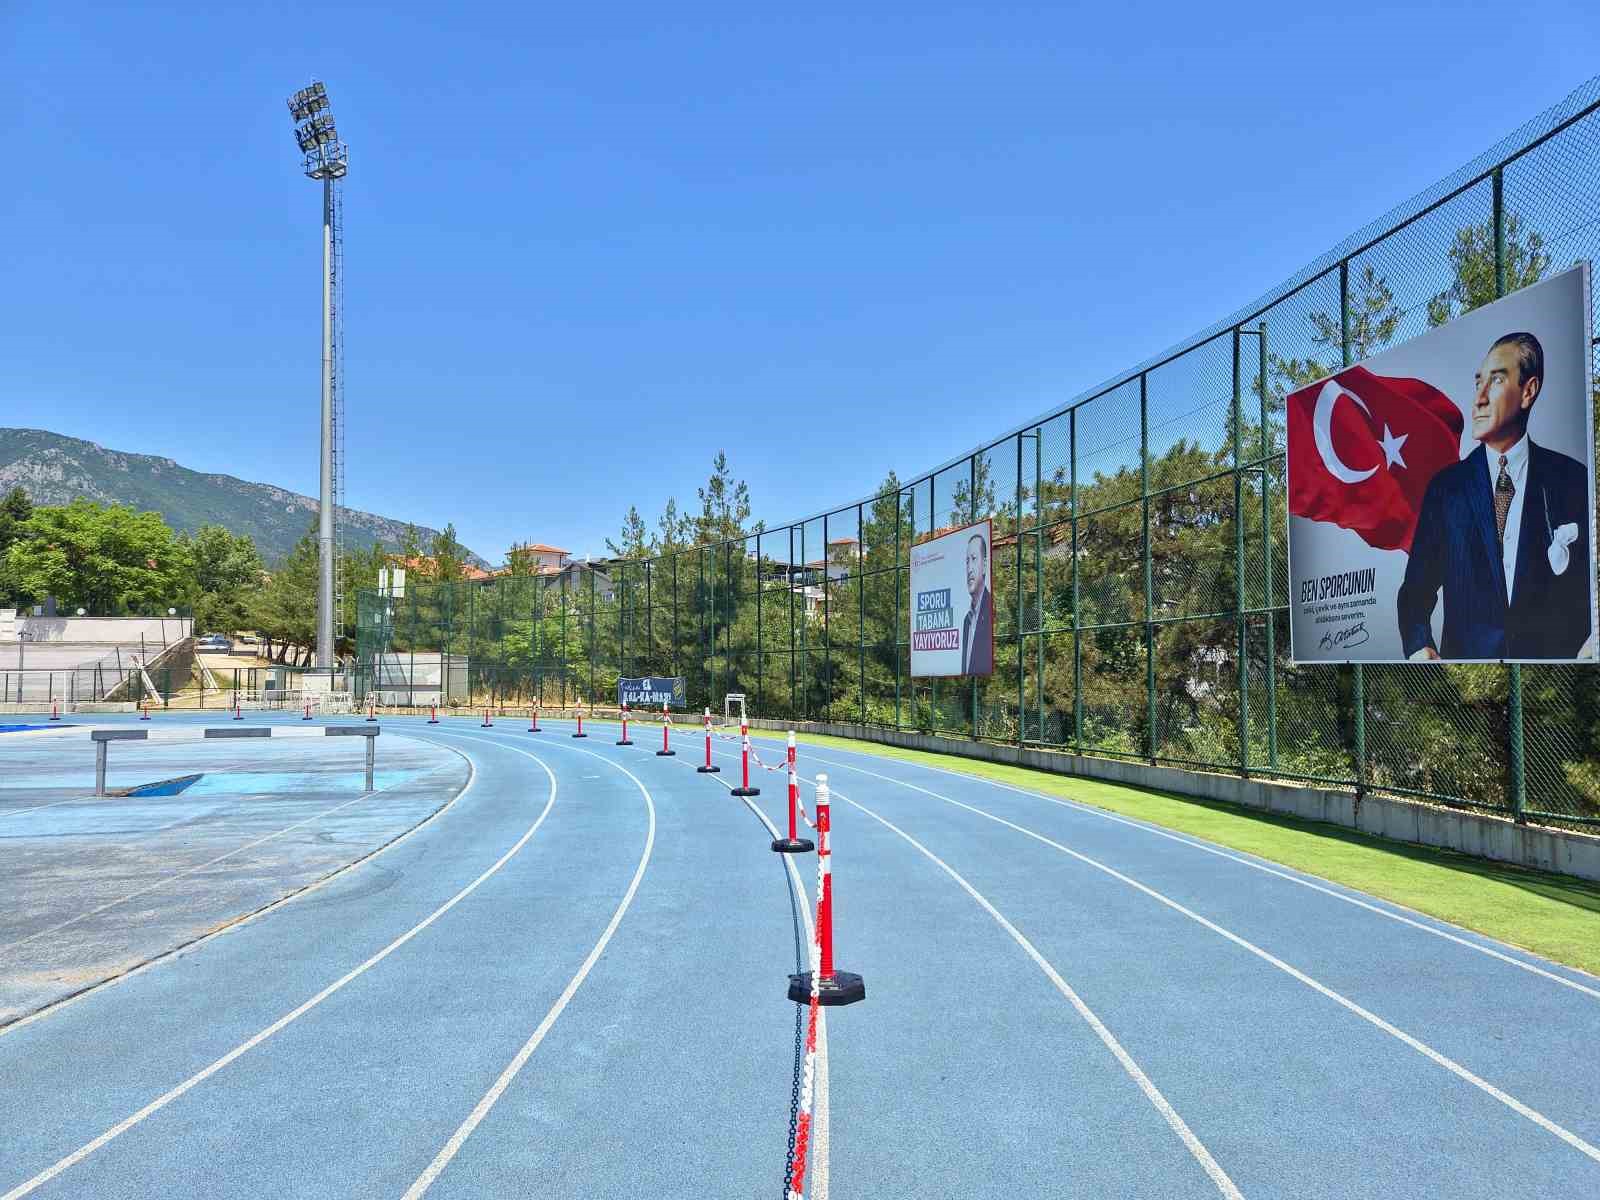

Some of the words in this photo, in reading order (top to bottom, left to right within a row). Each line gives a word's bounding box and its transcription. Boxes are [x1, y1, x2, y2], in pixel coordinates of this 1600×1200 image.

[1301, 579, 1318, 602] BEN
[1319, 568, 1376, 600] SPORCUNUN
[920, 591, 946, 609] SPORU
[1350, 598, 1377, 608] zamanda
[919, 609, 950, 631] TABANA
[914, 631, 958, 649] YAYIYORUZ
